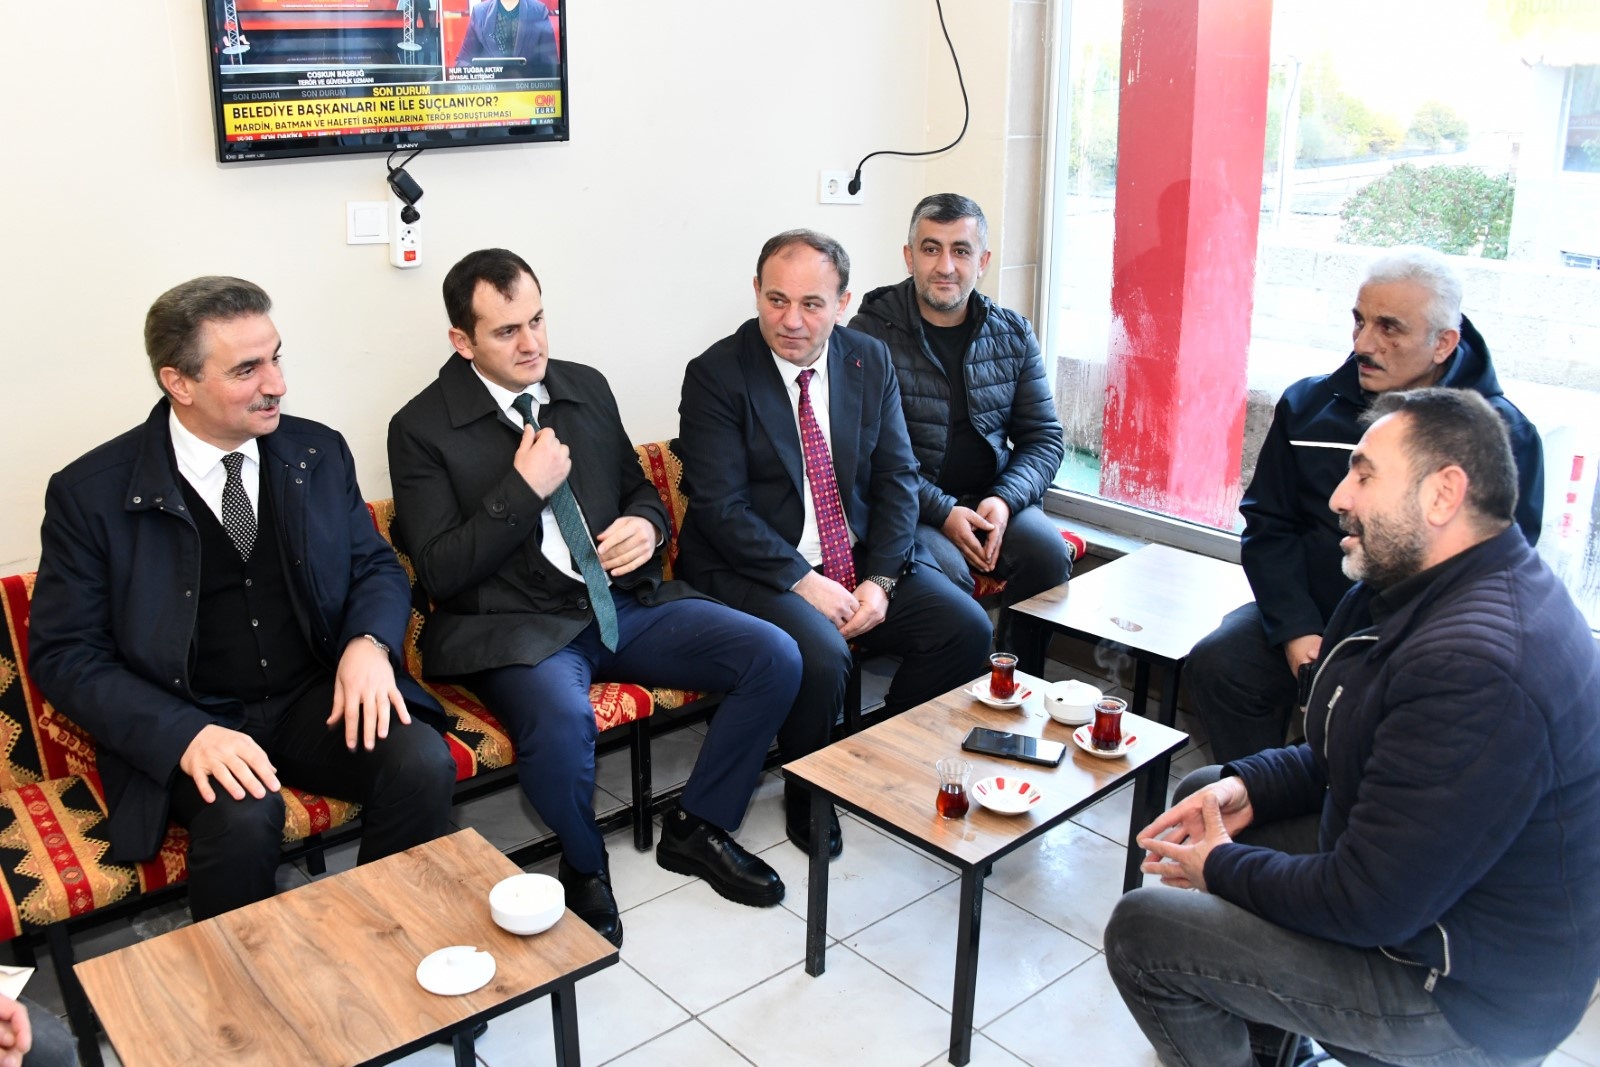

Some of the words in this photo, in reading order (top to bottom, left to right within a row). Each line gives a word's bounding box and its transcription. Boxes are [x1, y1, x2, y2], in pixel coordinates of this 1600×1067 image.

[463, 66, 484, 74] TUĞBA
[326, 77, 353, 85] GÜVENLİK
[515, 82, 529, 90] SON
[530, 81, 553, 89] DURUM
[372, 87, 394, 97] SON
[397, 85, 431, 96] DURUM
[472, 83, 497, 91] DURUM
[232, 93, 250, 101] SON
[251, 92, 280, 100] DURUM
[301, 90, 318, 98] SON
[319, 89, 347, 97] DURUM
[535, 94, 555, 106] CNN
[233, 103, 293, 119] BELEDİYE
[298, 101, 376, 117] BAŞKANLARI
[380, 100, 395, 112] NE
[399, 97, 415, 111] İLE
[418, 96, 499, 112] SUÇLANIYOR?
[234, 120, 273, 132] MARDİN,
[275, 119, 312, 130] BATMAN
[314, 118, 325, 127] VE
[327, 116, 360, 127] HALFETİ
[362, 113, 424, 126] BAŞKANLARINA
[426, 110, 451, 121] TERÖR
[453, 109, 512, 121] SORUŞTURMASI
